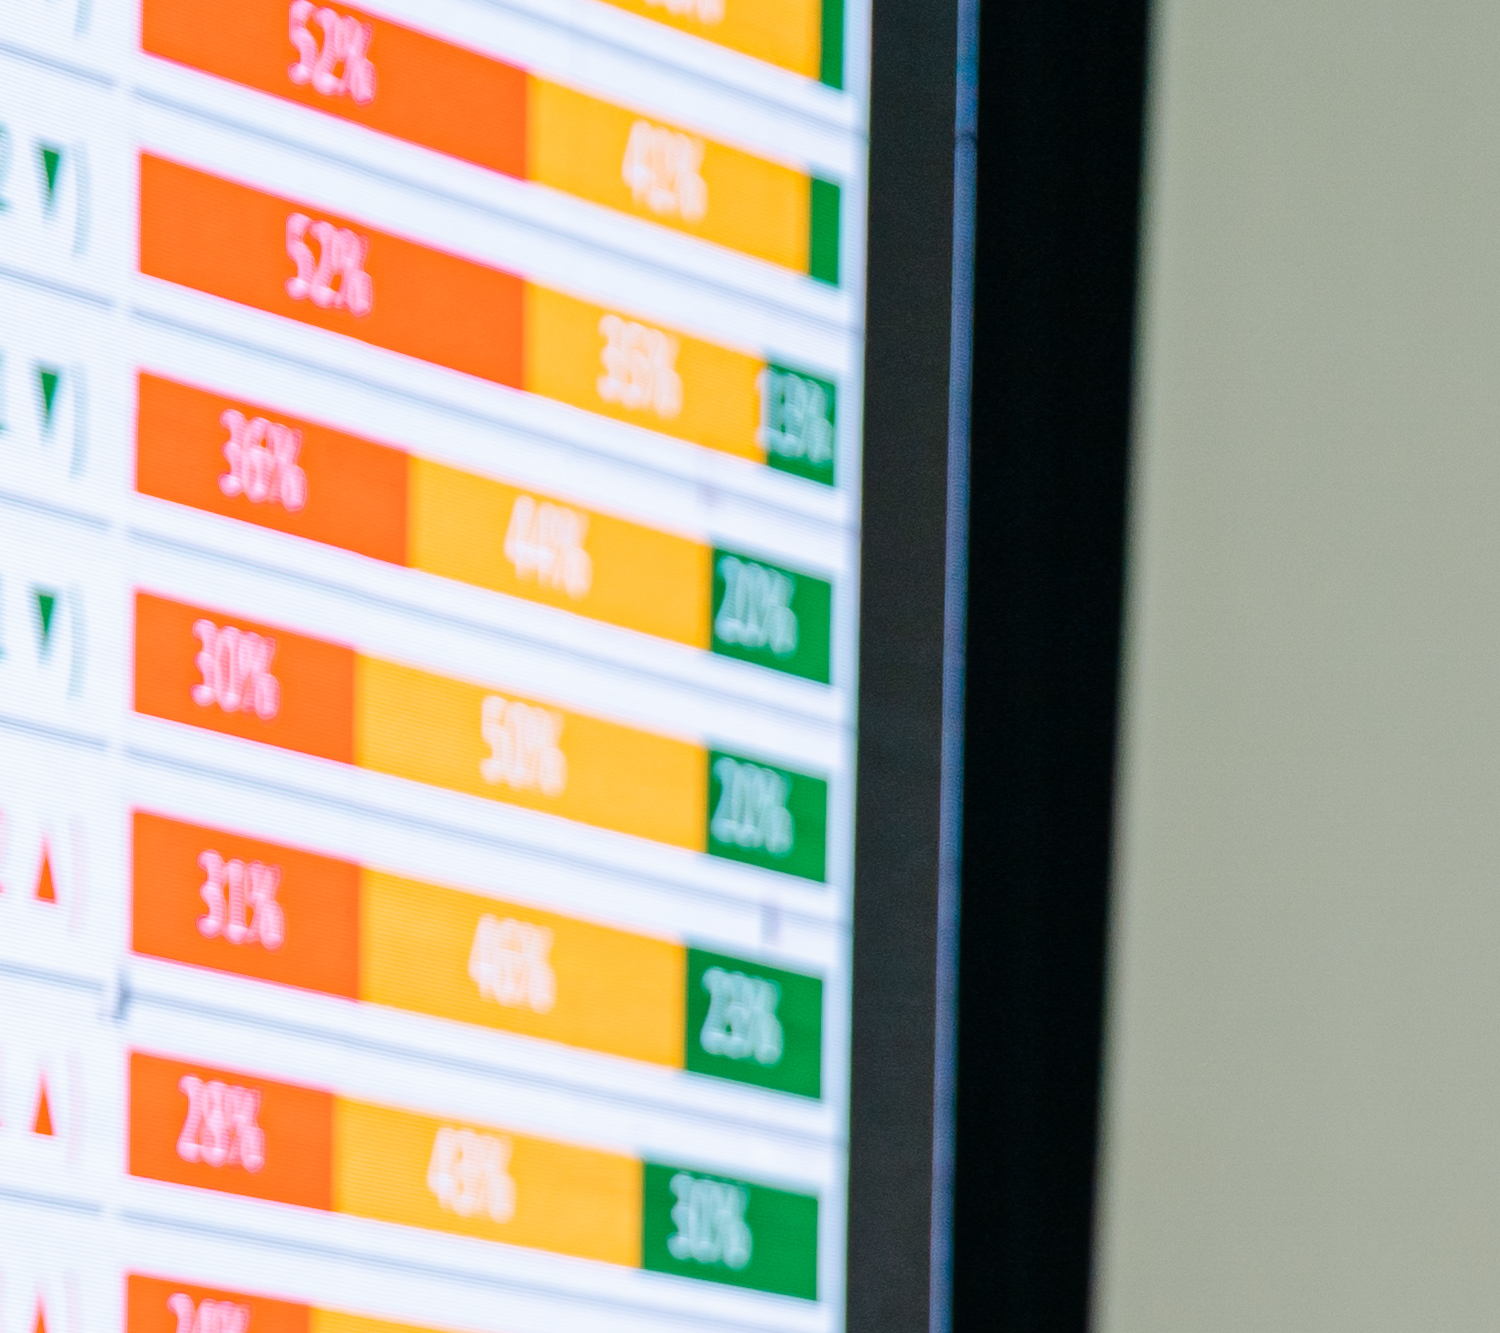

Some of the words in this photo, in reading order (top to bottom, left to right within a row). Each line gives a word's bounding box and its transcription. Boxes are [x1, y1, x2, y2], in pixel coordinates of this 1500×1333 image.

[286, 0, 378, 107] 52%
[283, 211, 375, 318] 52%
[216, 407, 309, 513] 36%
[502, 494, 593, 599] 44%
[195, 848, 287, 952] 31%
